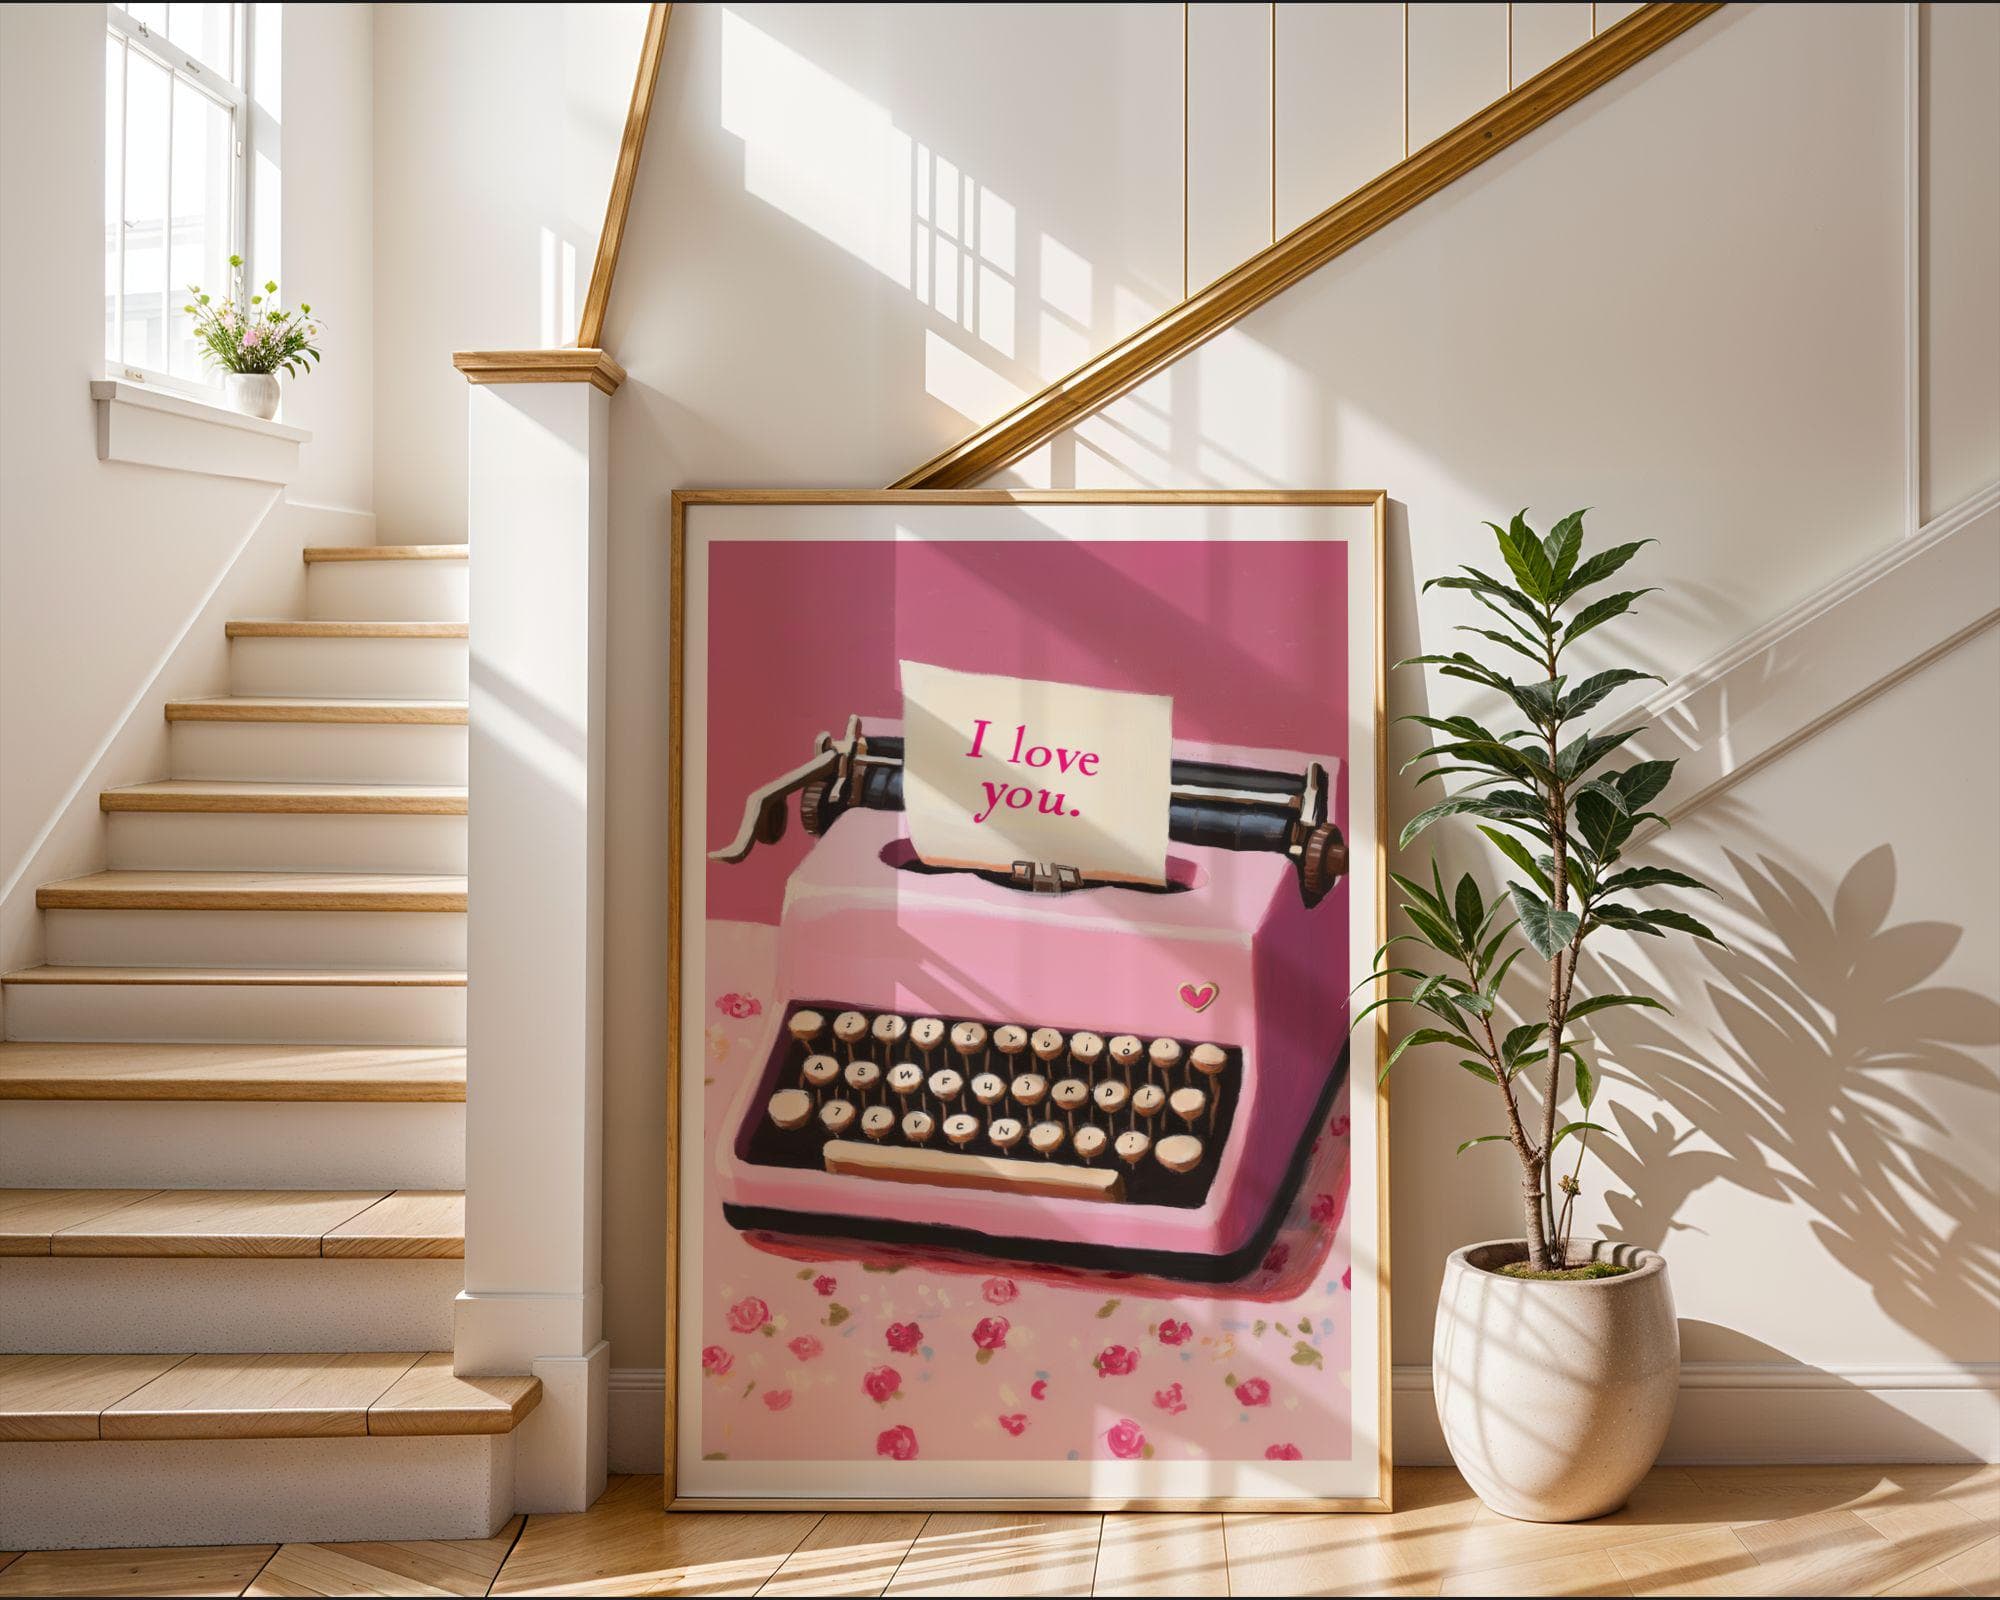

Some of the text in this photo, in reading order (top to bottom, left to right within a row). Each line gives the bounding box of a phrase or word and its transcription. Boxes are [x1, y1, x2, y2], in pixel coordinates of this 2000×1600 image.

[966, 719, 1100, 776] I love
[973, 781, 1080, 823] you.
[814, 1062, 824, 1071] A
[1065, 1086, 1075, 1095] K
[998, 1126, 1010, 1135] N
